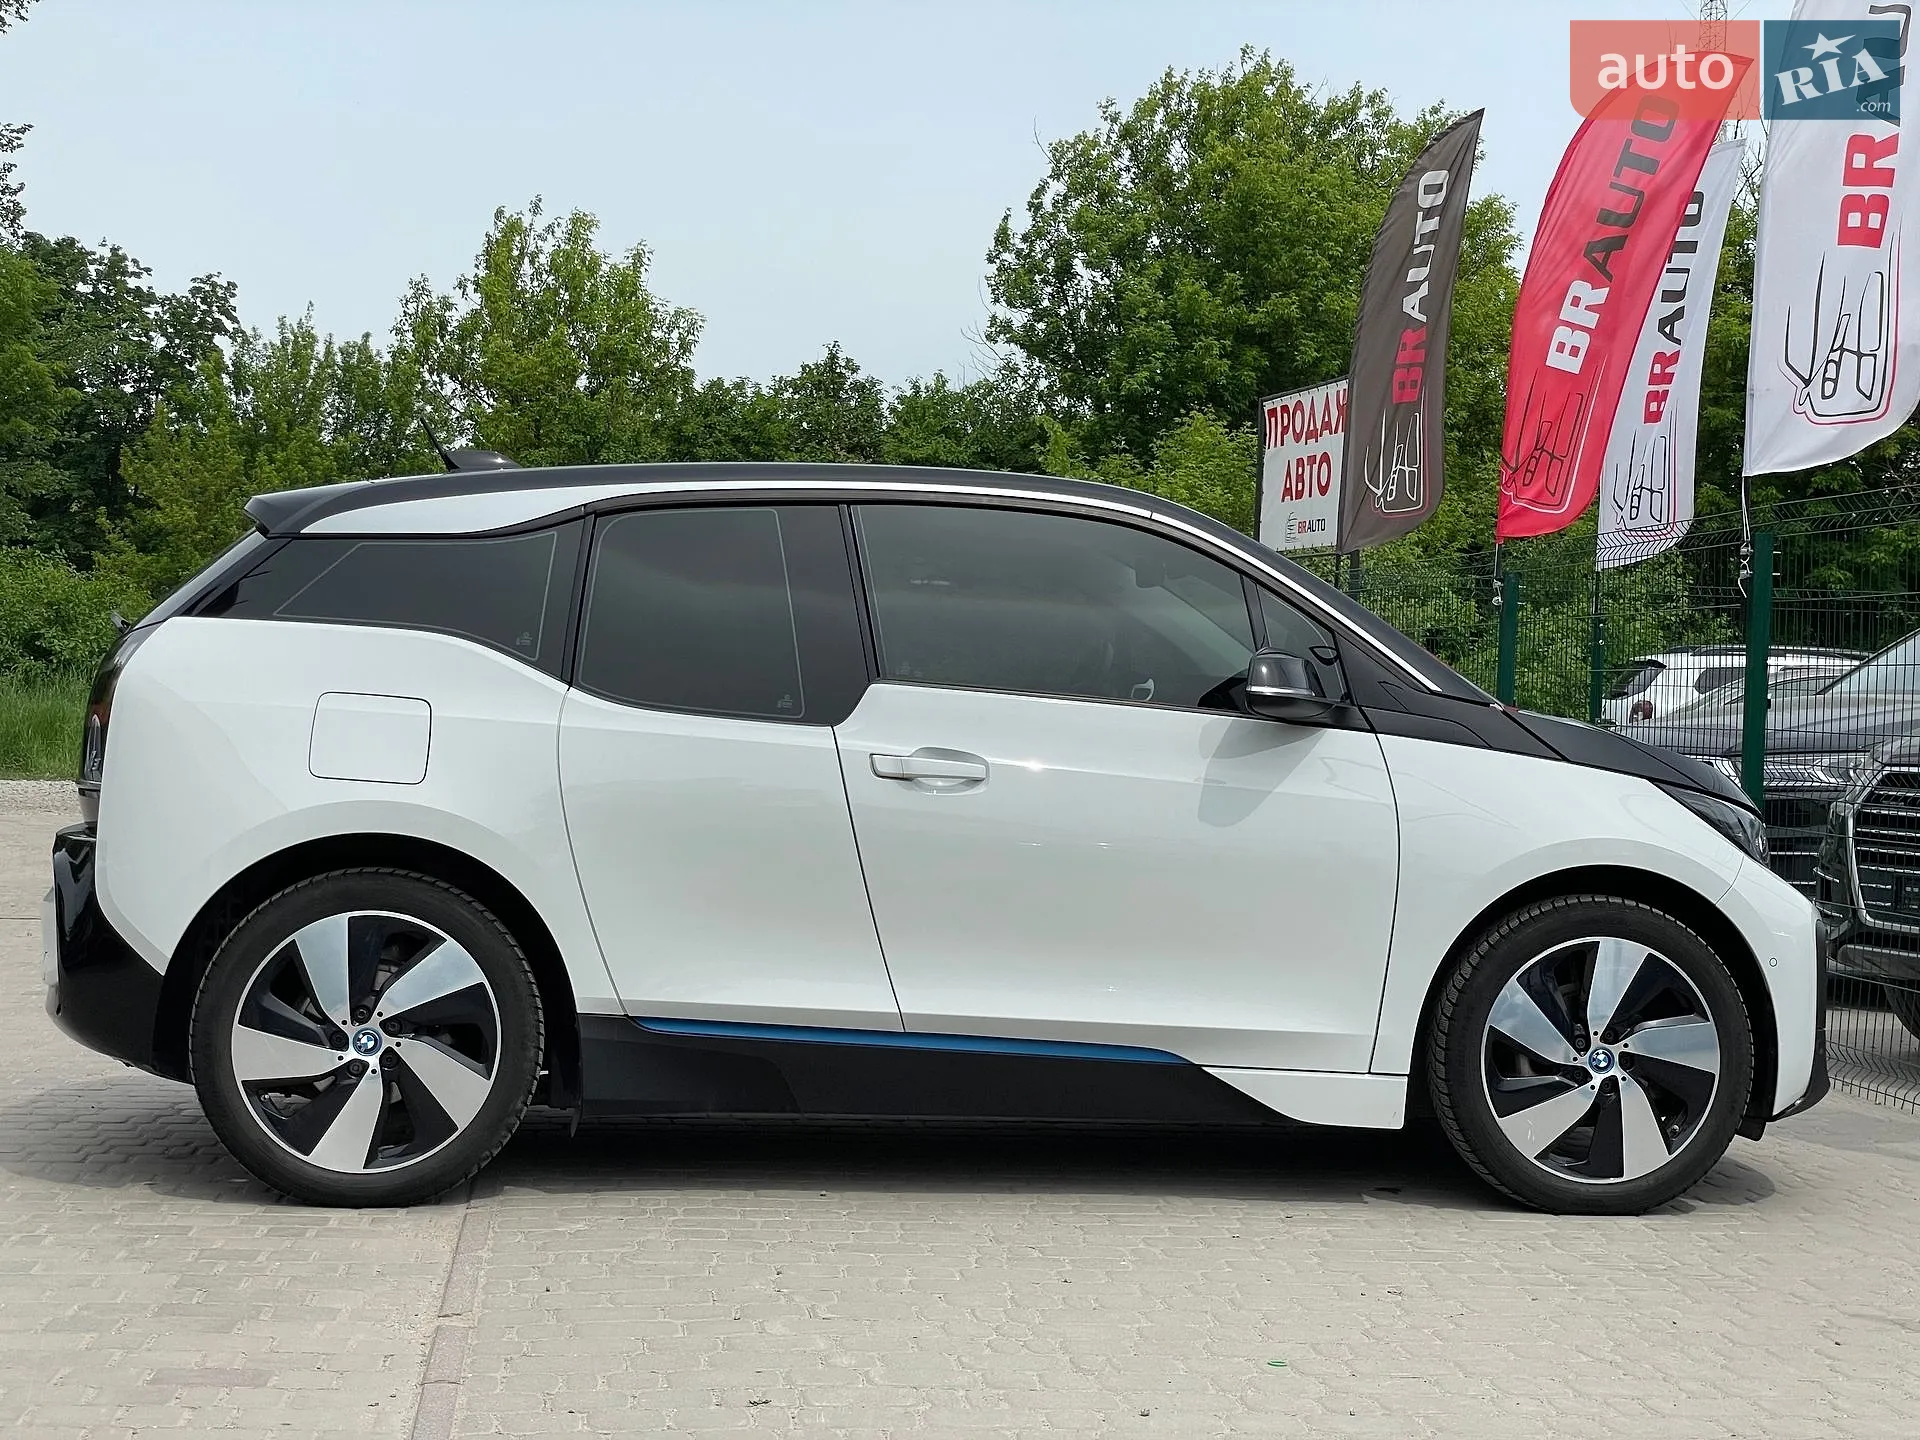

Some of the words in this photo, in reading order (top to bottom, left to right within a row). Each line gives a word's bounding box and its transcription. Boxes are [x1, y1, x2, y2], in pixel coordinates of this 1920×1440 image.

[1393, 170, 1449, 404] BRAUTO
[1545, 94, 1681, 375] BRAUTO
[1644, 190, 1705, 425] BRAUTO
[1281, 451, 1332, 503] АВТО
[1297, 518, 1326, 534] BRAUTO
